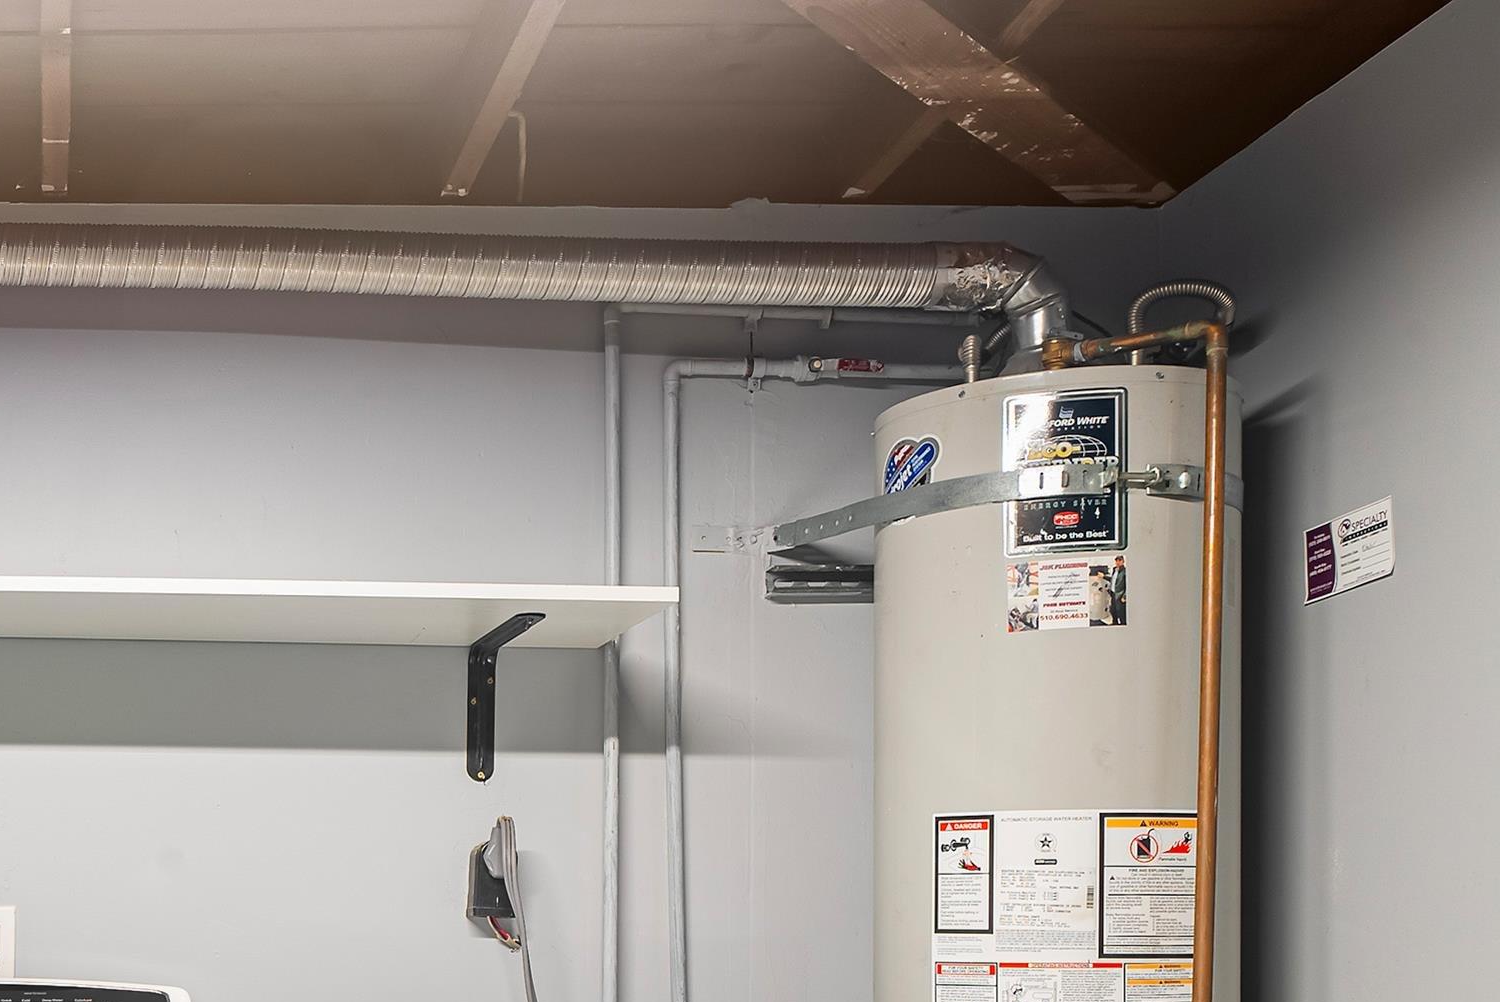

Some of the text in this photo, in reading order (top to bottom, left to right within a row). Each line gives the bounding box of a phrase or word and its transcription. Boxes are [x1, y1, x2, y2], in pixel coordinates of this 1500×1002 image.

[1076, 416, 1109, 426] WHITE
[1351, 510, 1387, 532] SPECIALTY
[1069, 531, 1084, 539] the
[954, 822, 982, 830] DANGER
